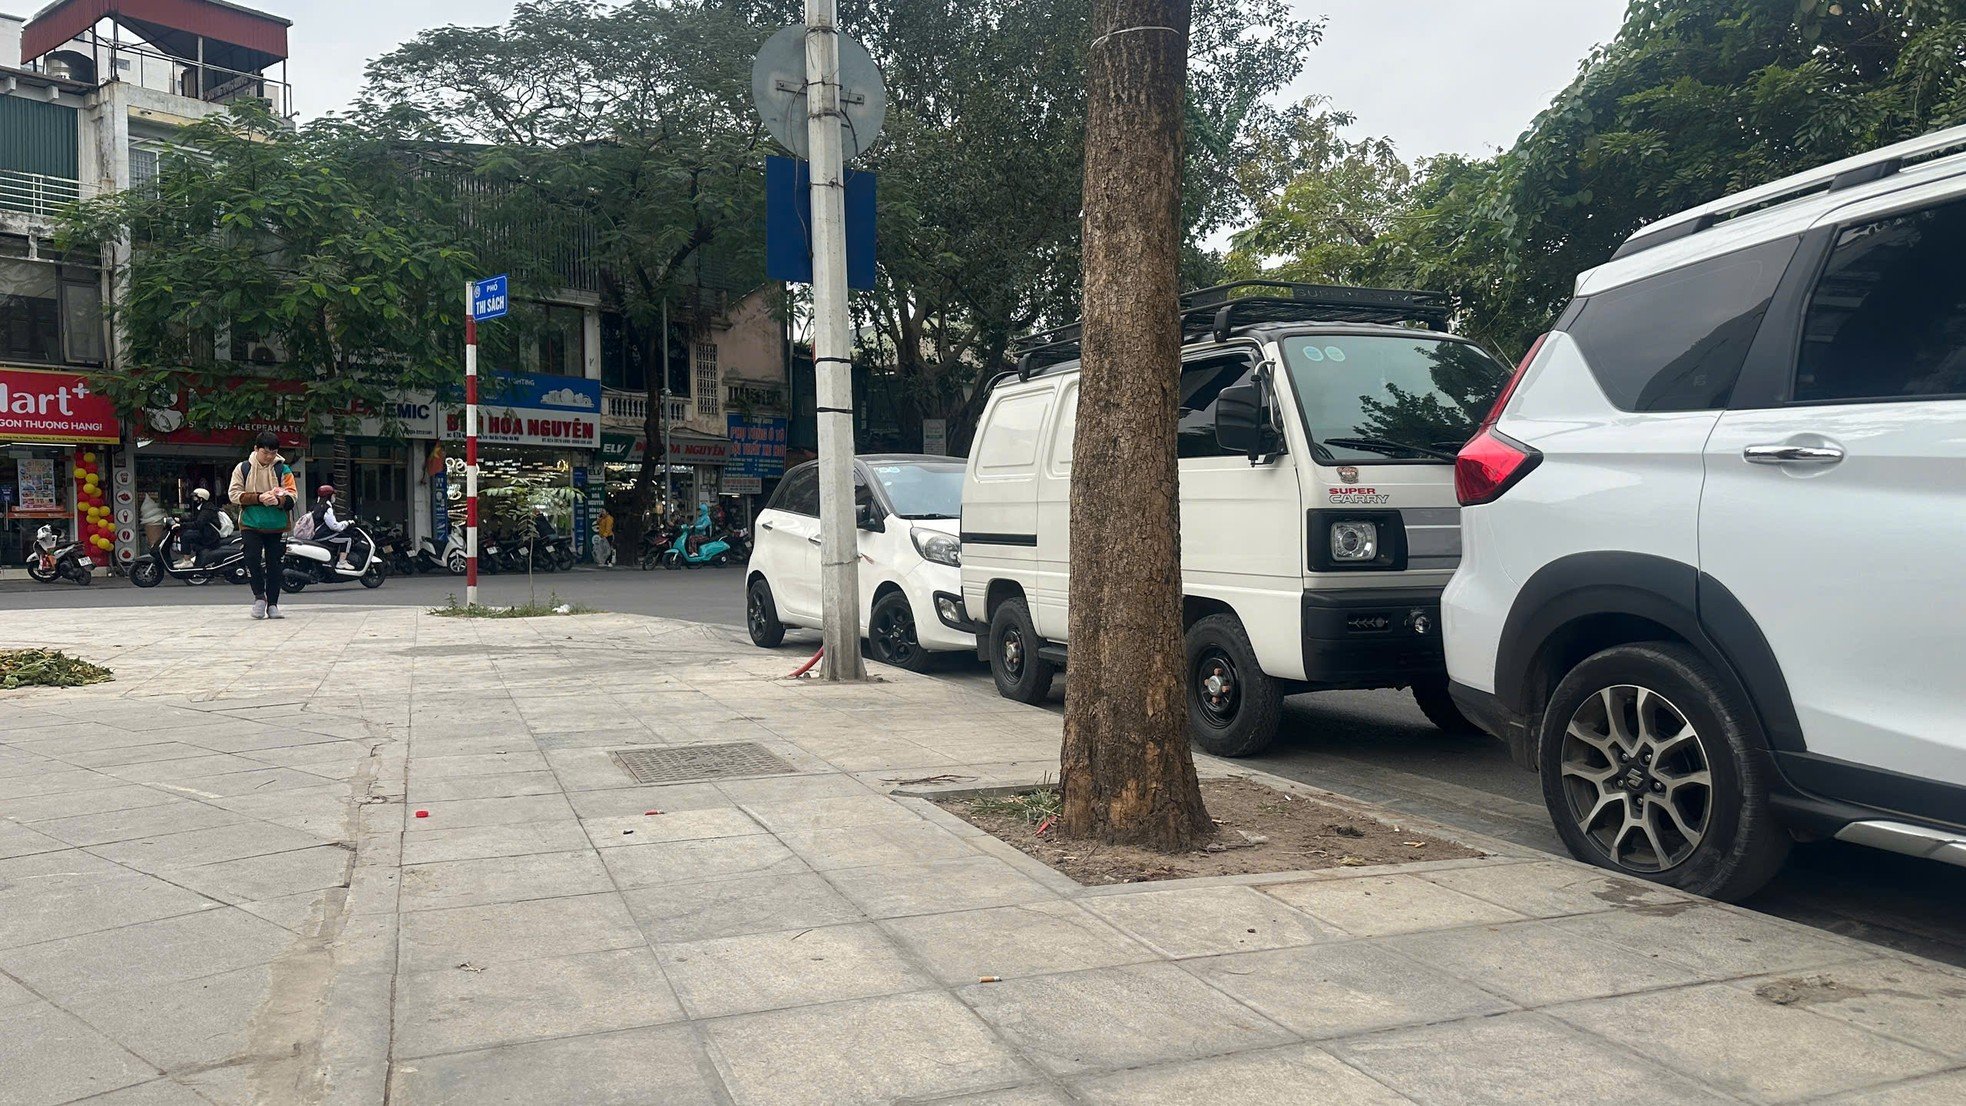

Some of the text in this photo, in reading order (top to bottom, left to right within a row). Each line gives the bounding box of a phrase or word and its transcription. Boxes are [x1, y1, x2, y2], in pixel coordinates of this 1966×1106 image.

[486, 280, 498, 292] PHỐ
[476, 294, 505, 315] THI SÁCH
[527, 417, 594, 440] NGUYÊN
[603, 443, 626, 453] ELV
[1328, 495, 1390, 504] CARRY
